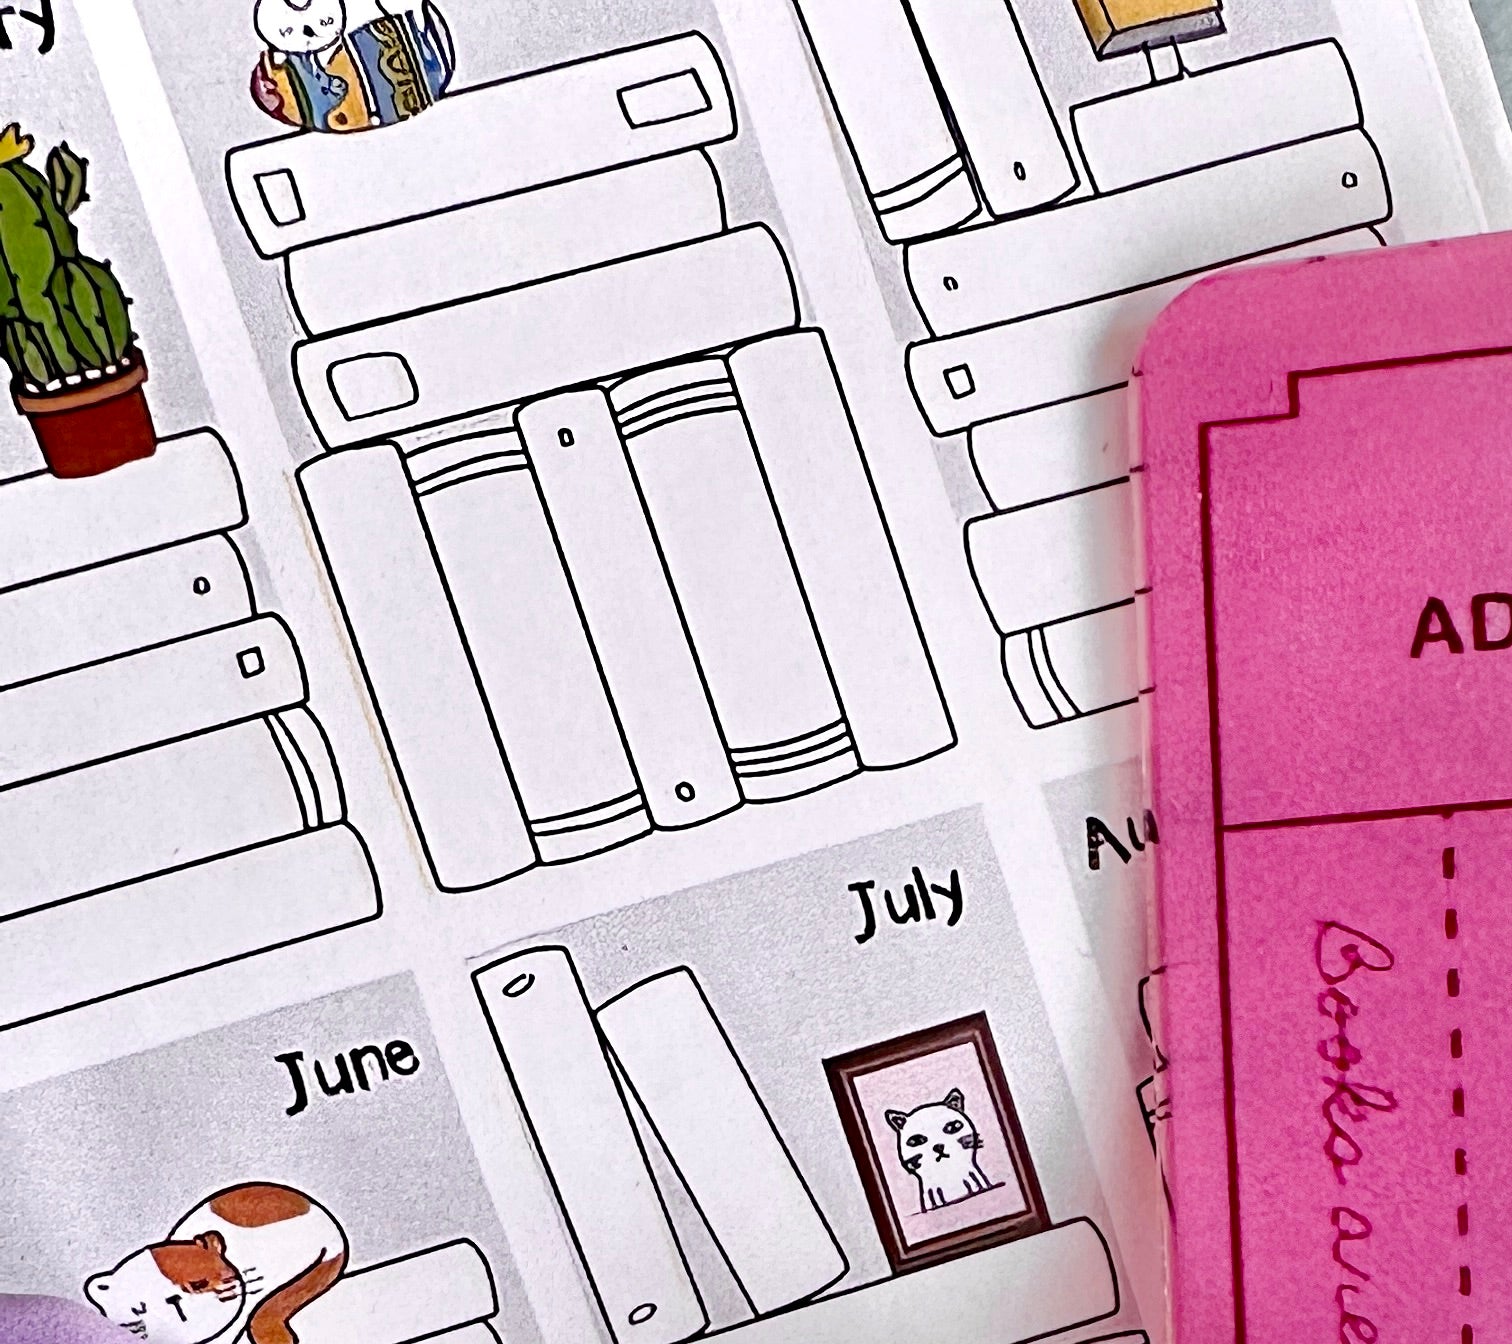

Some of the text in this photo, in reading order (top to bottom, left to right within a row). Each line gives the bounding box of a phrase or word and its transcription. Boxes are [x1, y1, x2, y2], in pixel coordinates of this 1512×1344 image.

[847, 866, 963, 944] July
[273, 1039, 420, 1117] June
[1314, 918, 1398, 1186] Books
